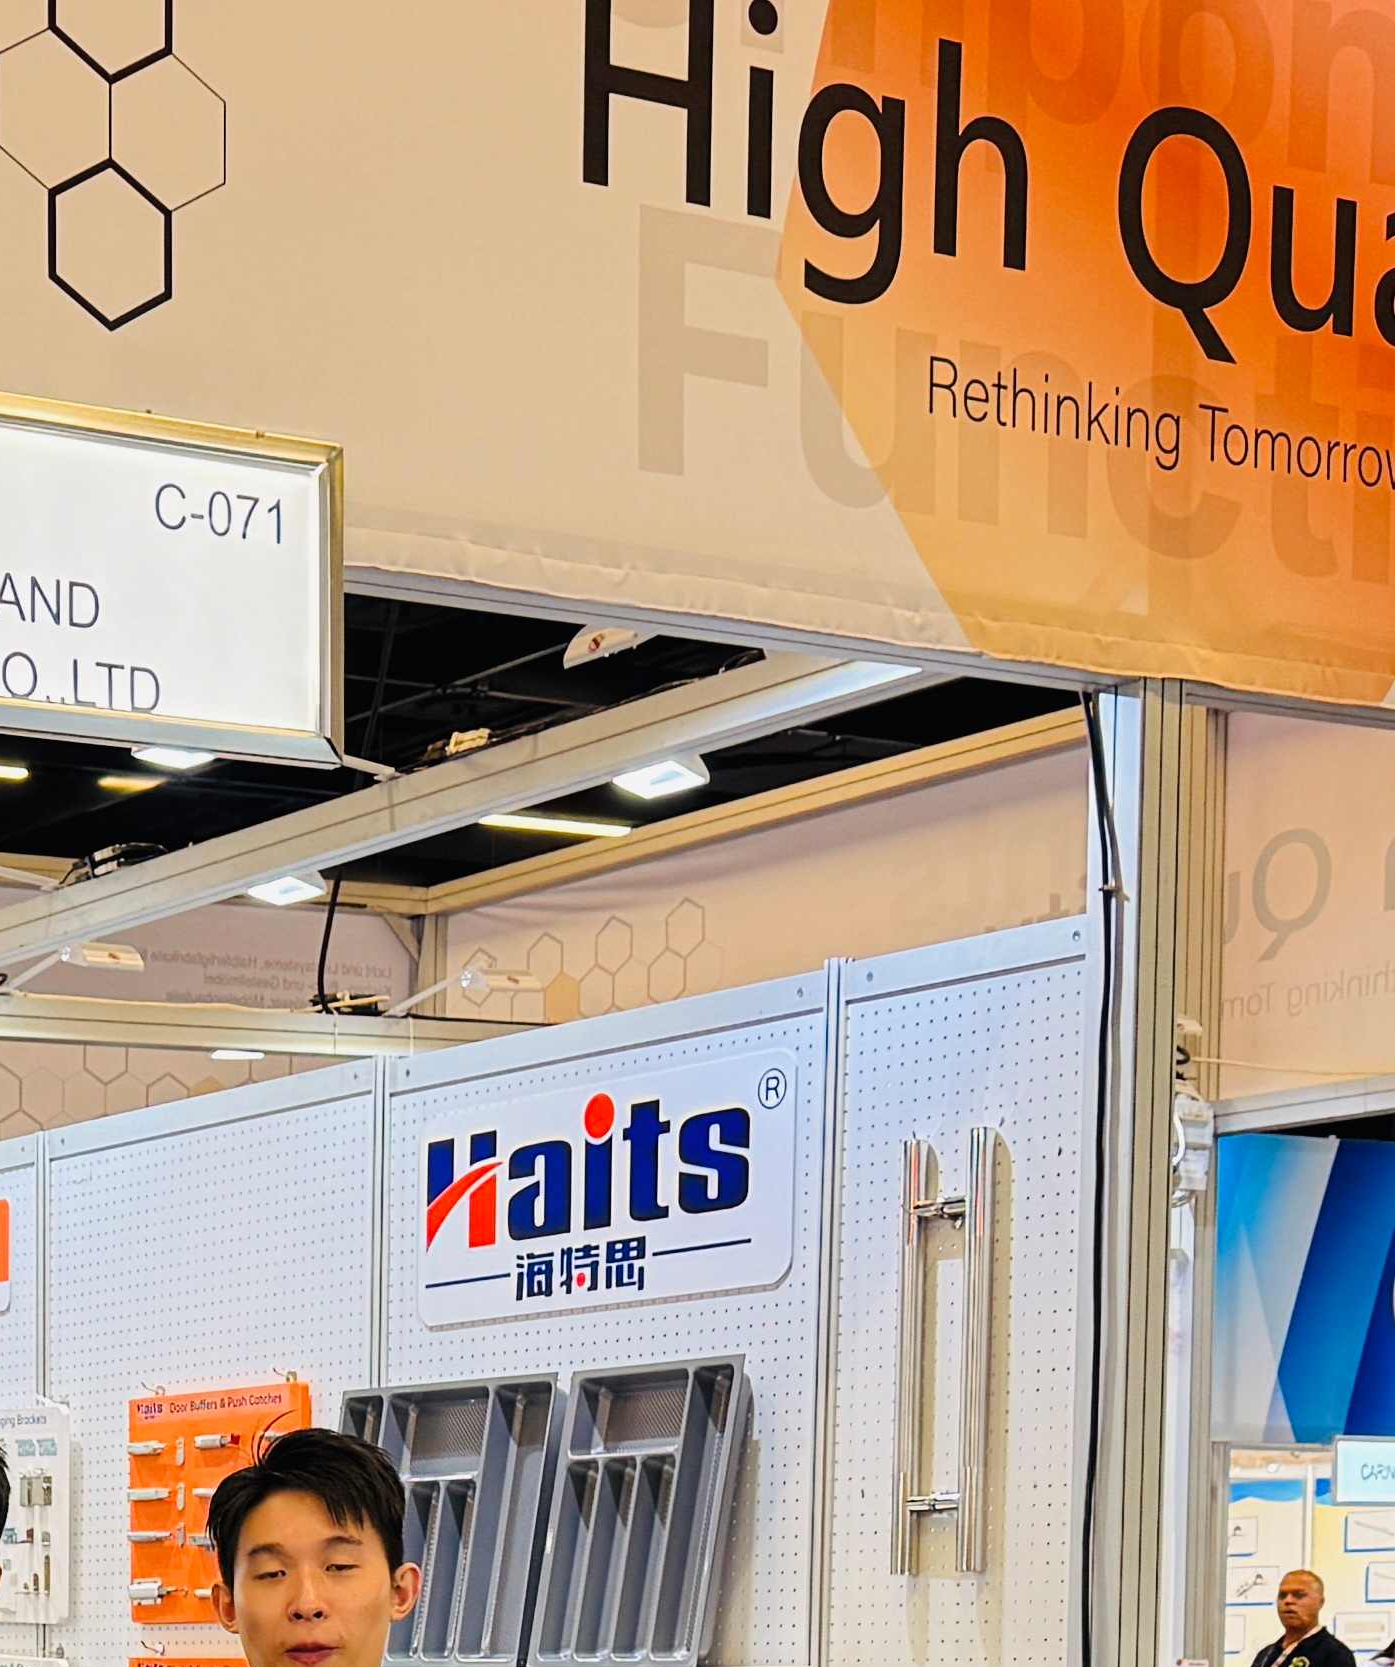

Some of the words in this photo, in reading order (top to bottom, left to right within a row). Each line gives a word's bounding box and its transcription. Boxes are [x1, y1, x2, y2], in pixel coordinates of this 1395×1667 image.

[582, 0, 1028, 304] High
[1118, 107, 1395, 363] Qu
[928, 355, 1182, 470] Rethinking
[1200, 404, 1395, 490] Tomorro
[153, 482, 288, 548] C-071
[426, 1093, 751, 1253] Haits
[515, 1235, 647, 1302] 海特思
